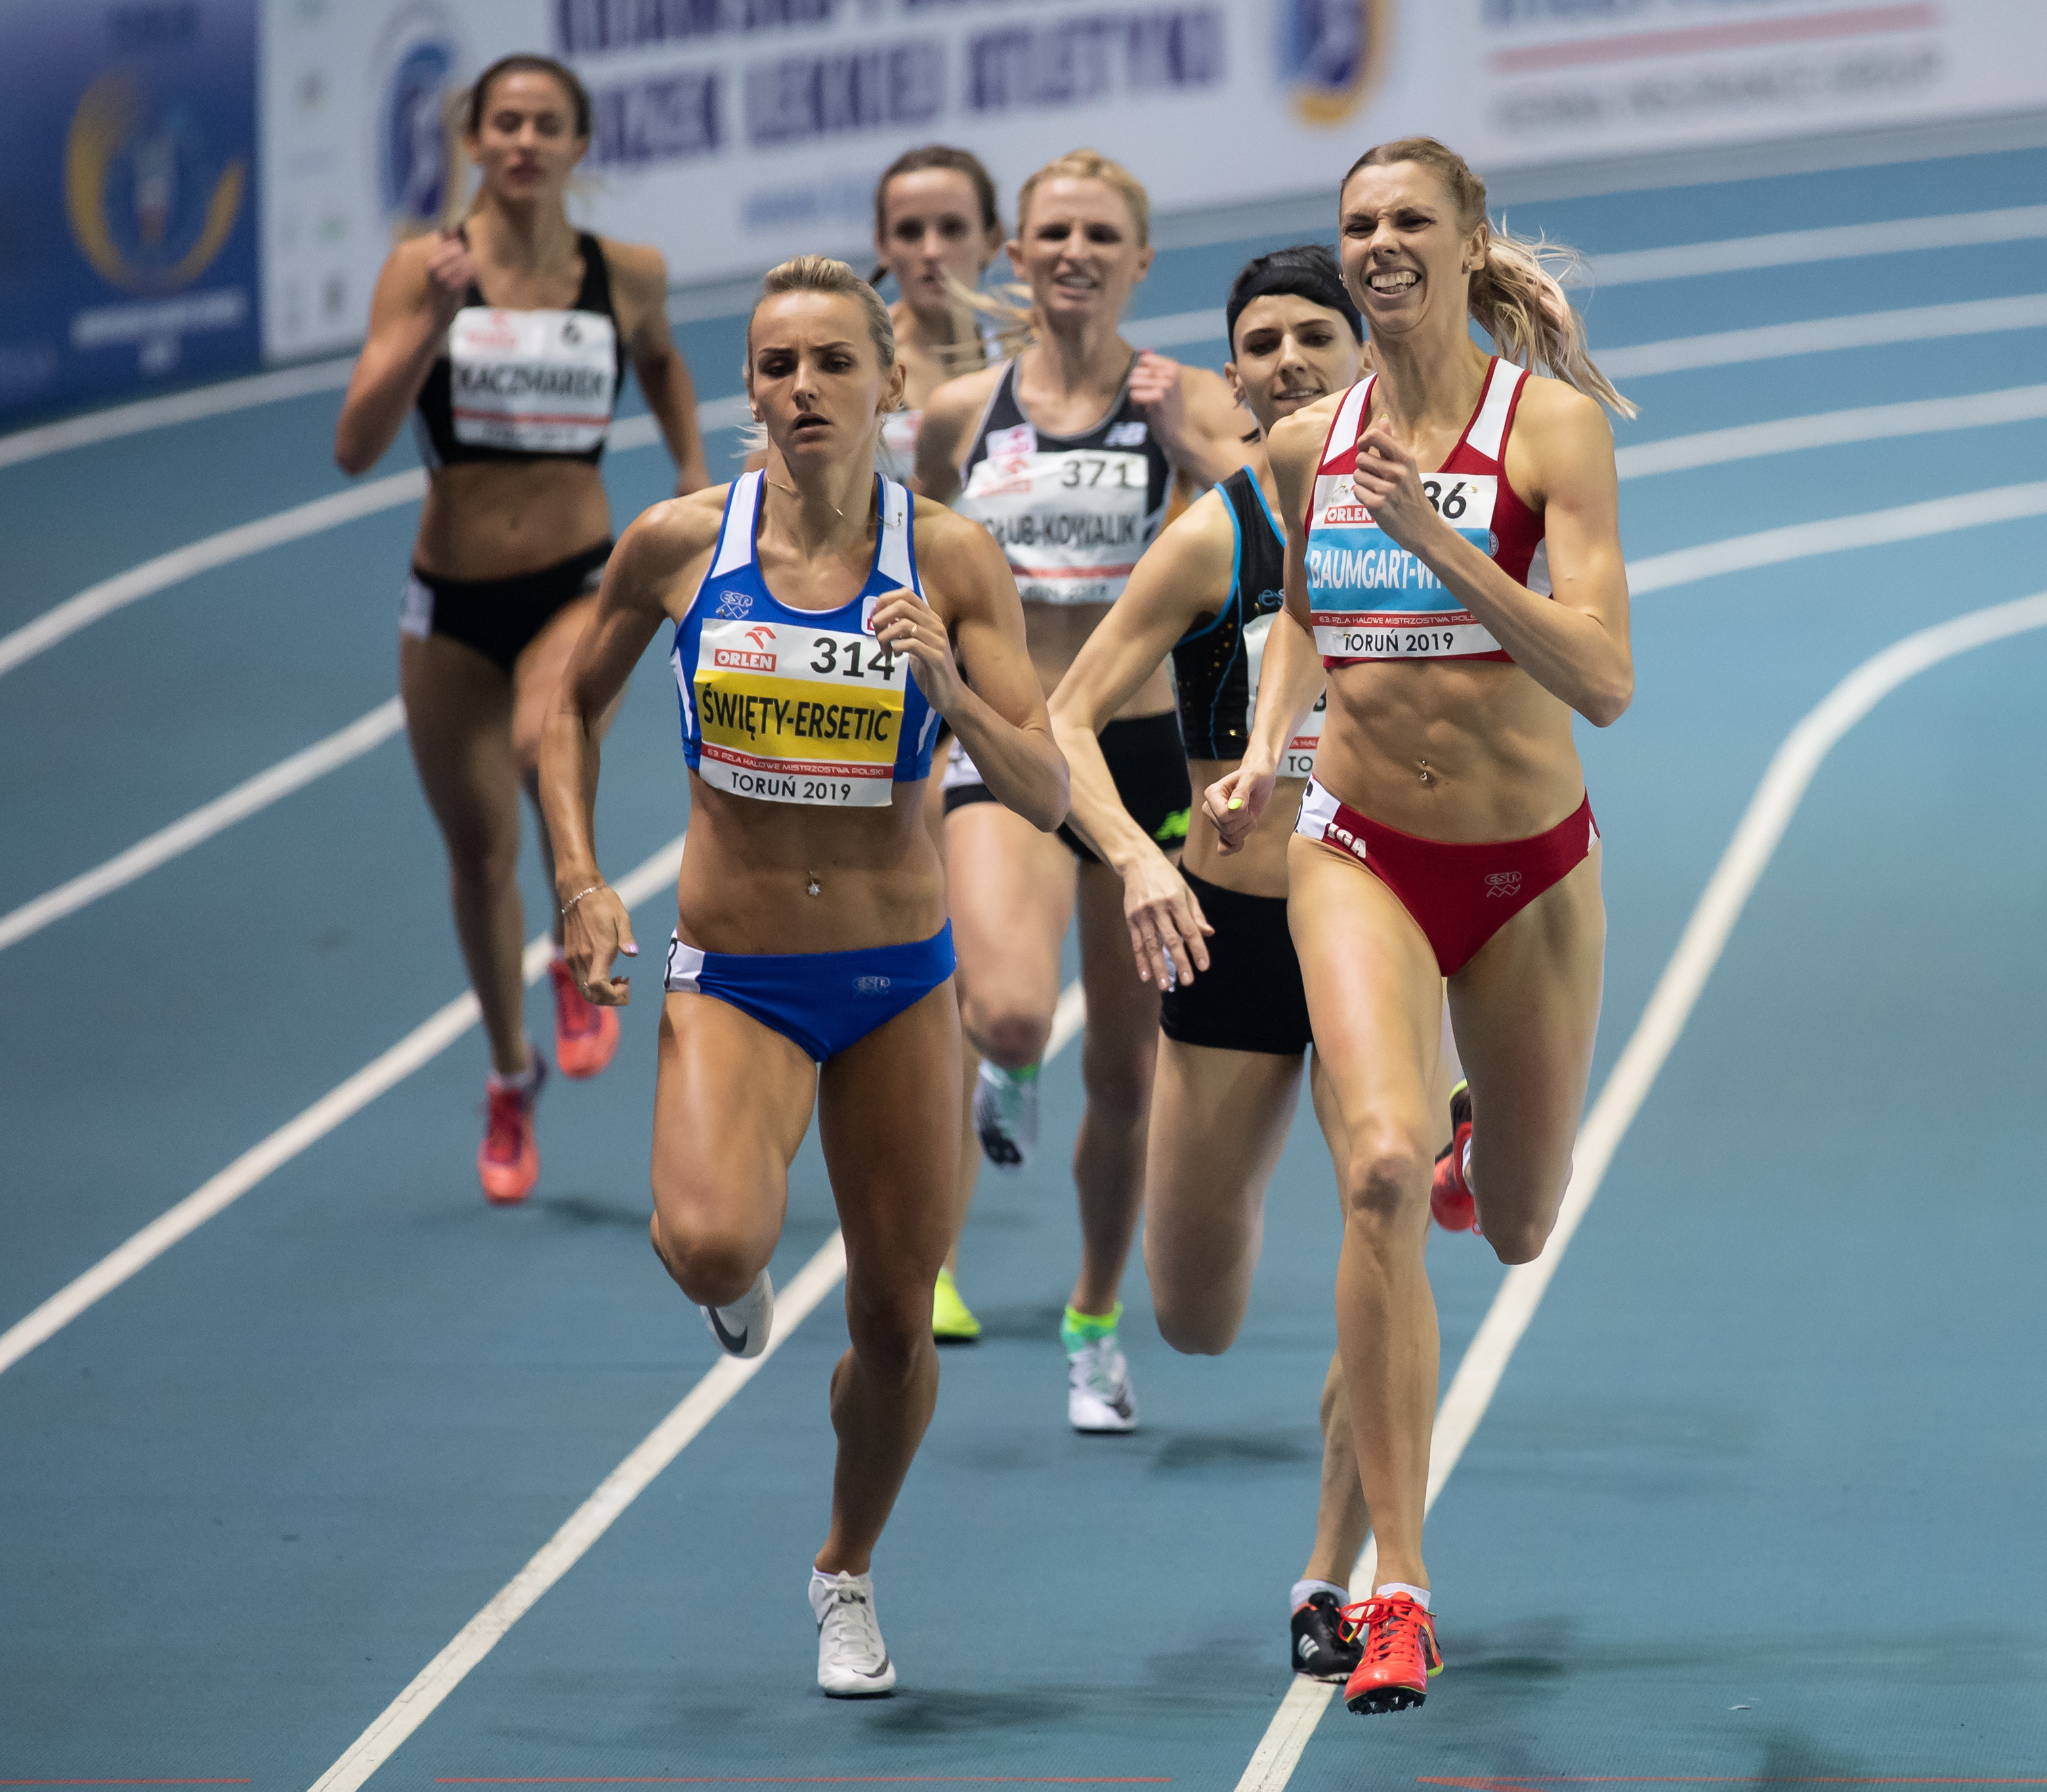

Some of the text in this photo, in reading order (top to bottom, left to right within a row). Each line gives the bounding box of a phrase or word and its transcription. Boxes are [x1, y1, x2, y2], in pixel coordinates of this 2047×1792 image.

[1061, 459, 1128, 488] 371
[1327, 507, 1372, 522] ORLEN
[1309, 549, 1441, 589] BAUMGART-W
[1385, 616, 1449, 624] MISTRZOSTWA
[1343, 629, 1454, 652] TORUŃ 2019
[717, 651, 773, 670] ORLEN
[809, 637, 895, 681] 314
[702, 683, 892, 741] ŚWIĘTY-ERSETIC
[743, 759, 780, 769] HALOWE
[782, 764, 849, 774] MISTRZOSTWA
[851, 767, 884, 775] POLSKI
[732, 772, 851, 801] TORUŃ 2019
